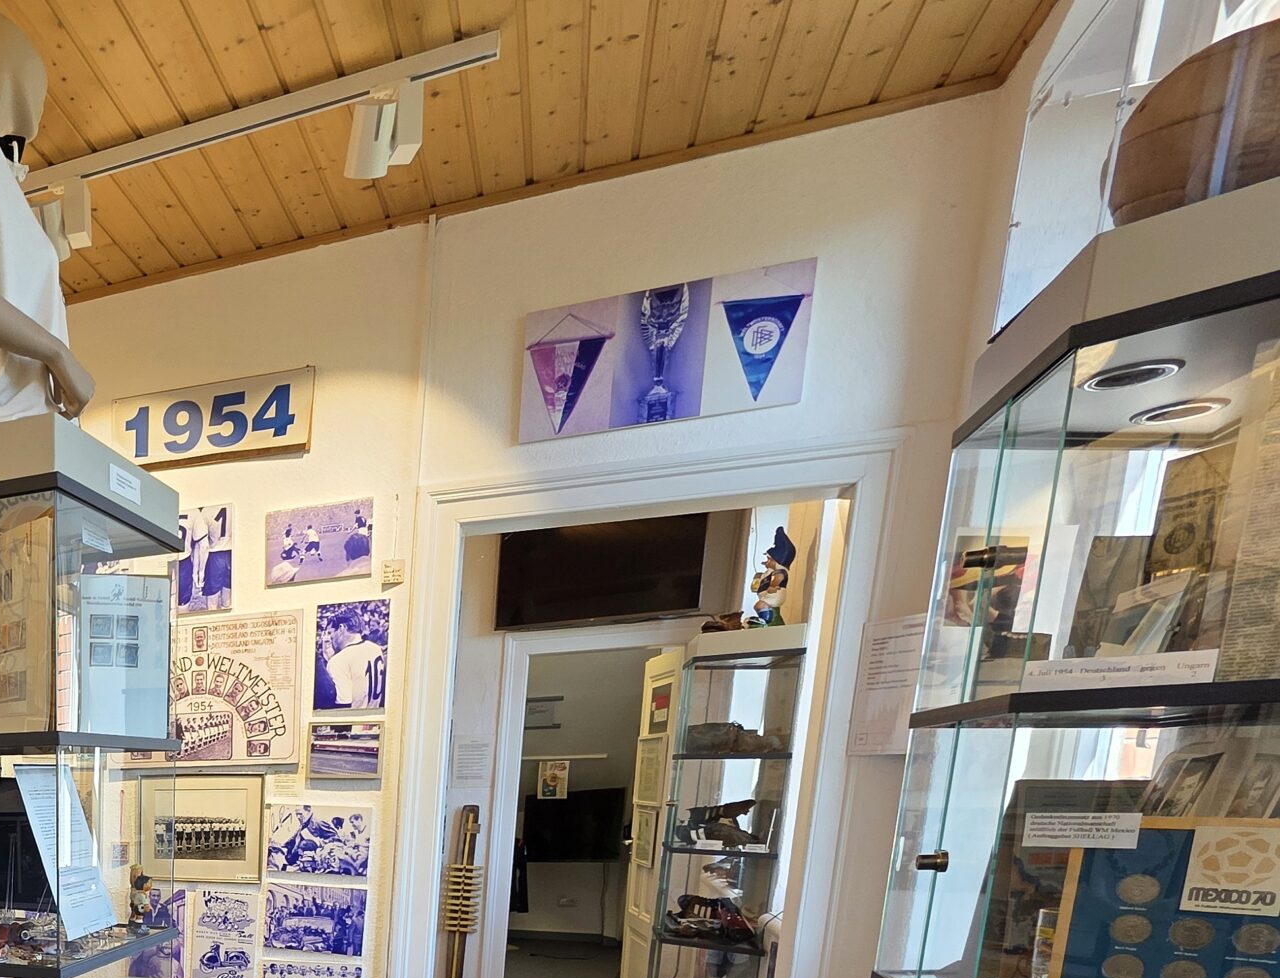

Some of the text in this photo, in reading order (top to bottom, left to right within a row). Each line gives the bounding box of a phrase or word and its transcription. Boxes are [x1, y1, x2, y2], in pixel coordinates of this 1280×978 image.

[124, 383, 296, 458] 1954
[1079, 665, 1131, 674] Deutschland
[1176, 662, 1211, 670] Ungarn
[187, 700, 214, 712] 1954
[206, 653, 287, 740] WELTMEISTER
[1187, 886, 1277, 907] MEXICO 70
